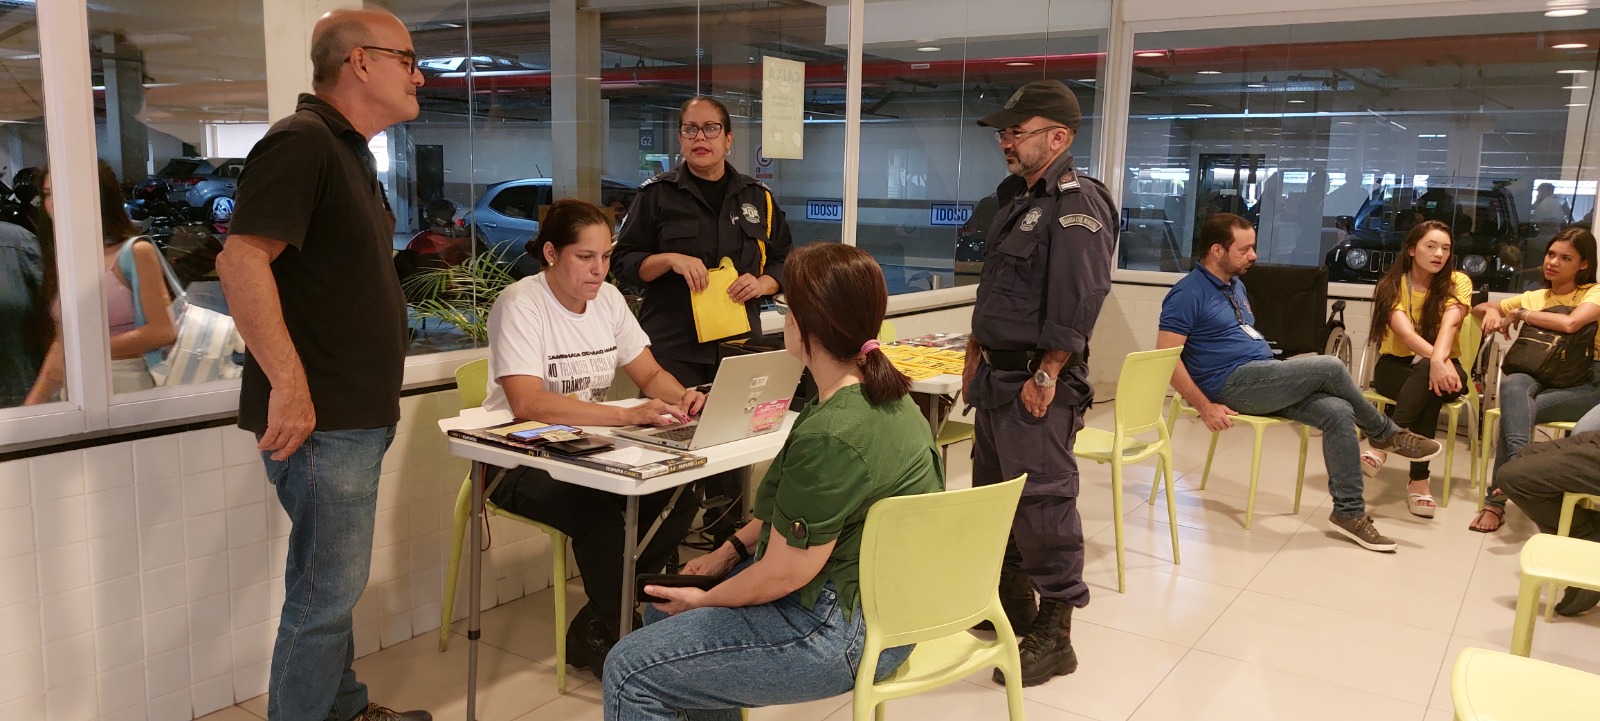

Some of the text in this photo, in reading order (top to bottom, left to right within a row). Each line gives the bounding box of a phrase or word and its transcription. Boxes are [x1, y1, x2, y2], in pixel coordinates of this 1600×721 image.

[641, 136, 652, 146] G2
[810, 204, 838, 217] IDOSO
[935, 208, 968, 221] IDOSO
[548, 363, 558, 378] NO
